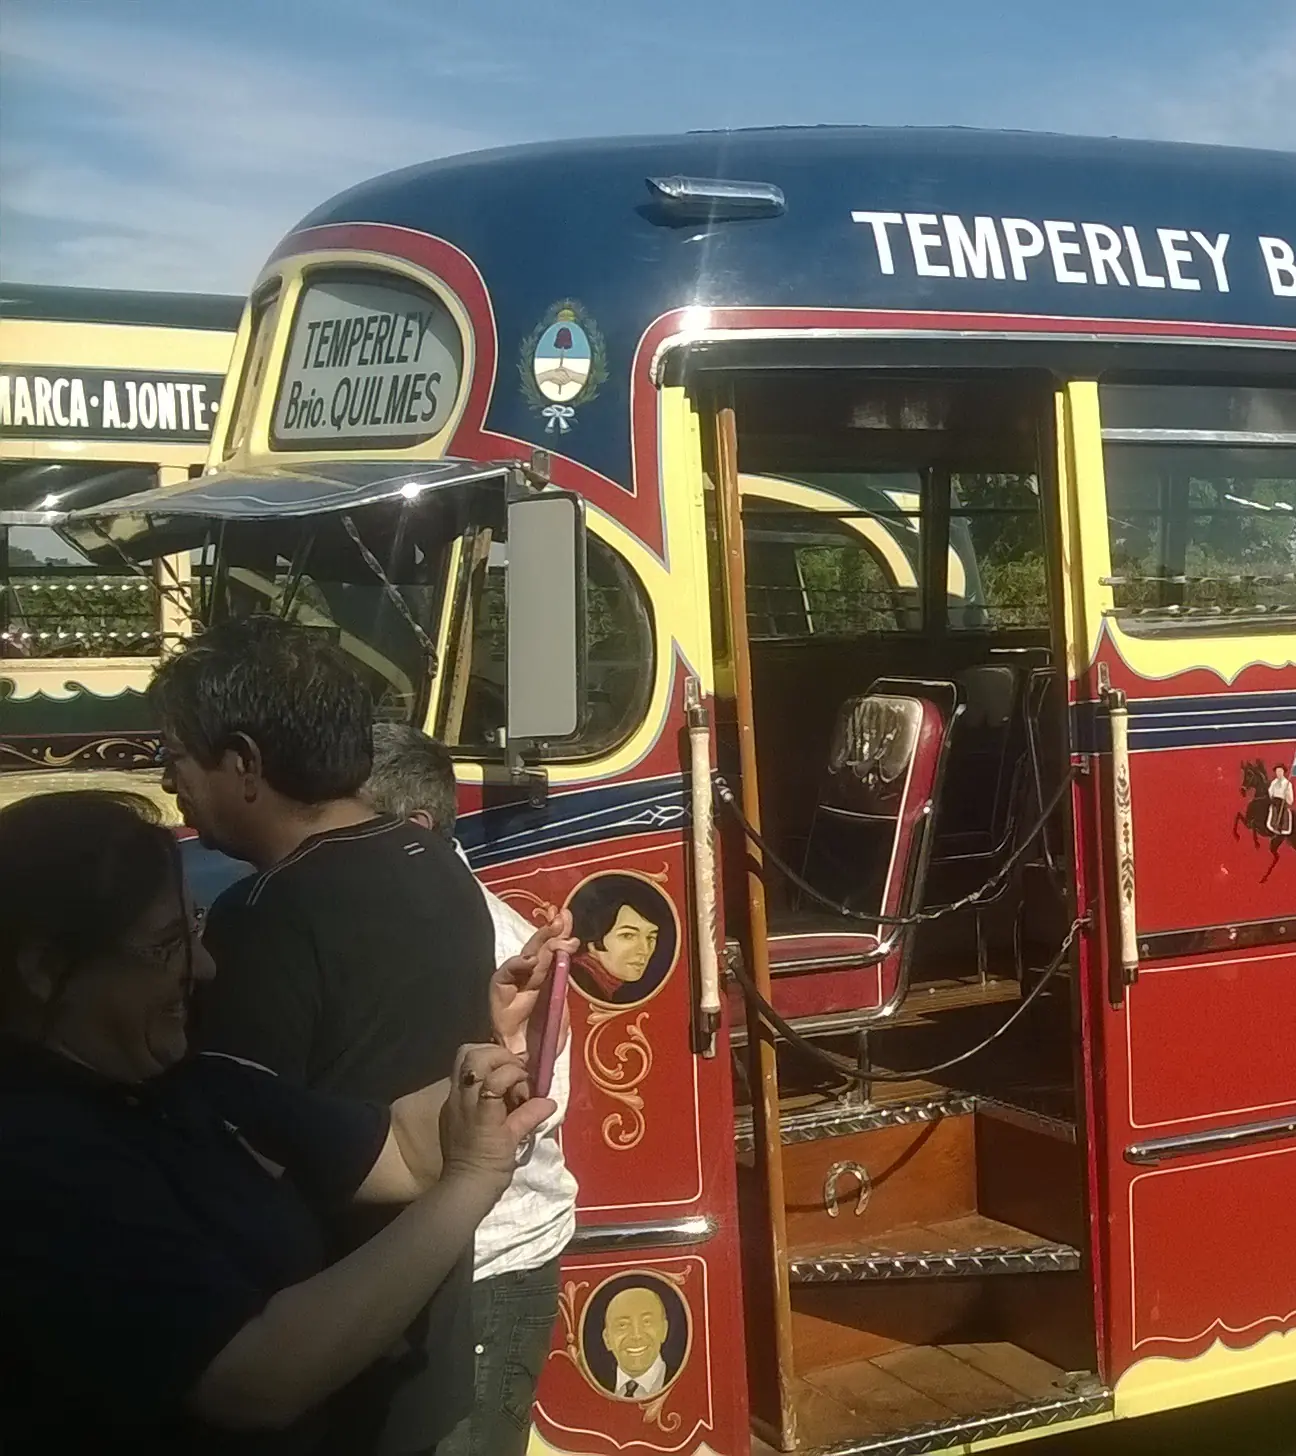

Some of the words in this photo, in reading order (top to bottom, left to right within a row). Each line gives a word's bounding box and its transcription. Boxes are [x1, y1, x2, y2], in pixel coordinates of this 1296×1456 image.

[851, 210, 1231, 294] TEMPERLEY
[301, 310, 435, 370] TEMPERLEY
[283, 380, 327, 430] Brio.
[330, 372, 442, 432] QUILMES
